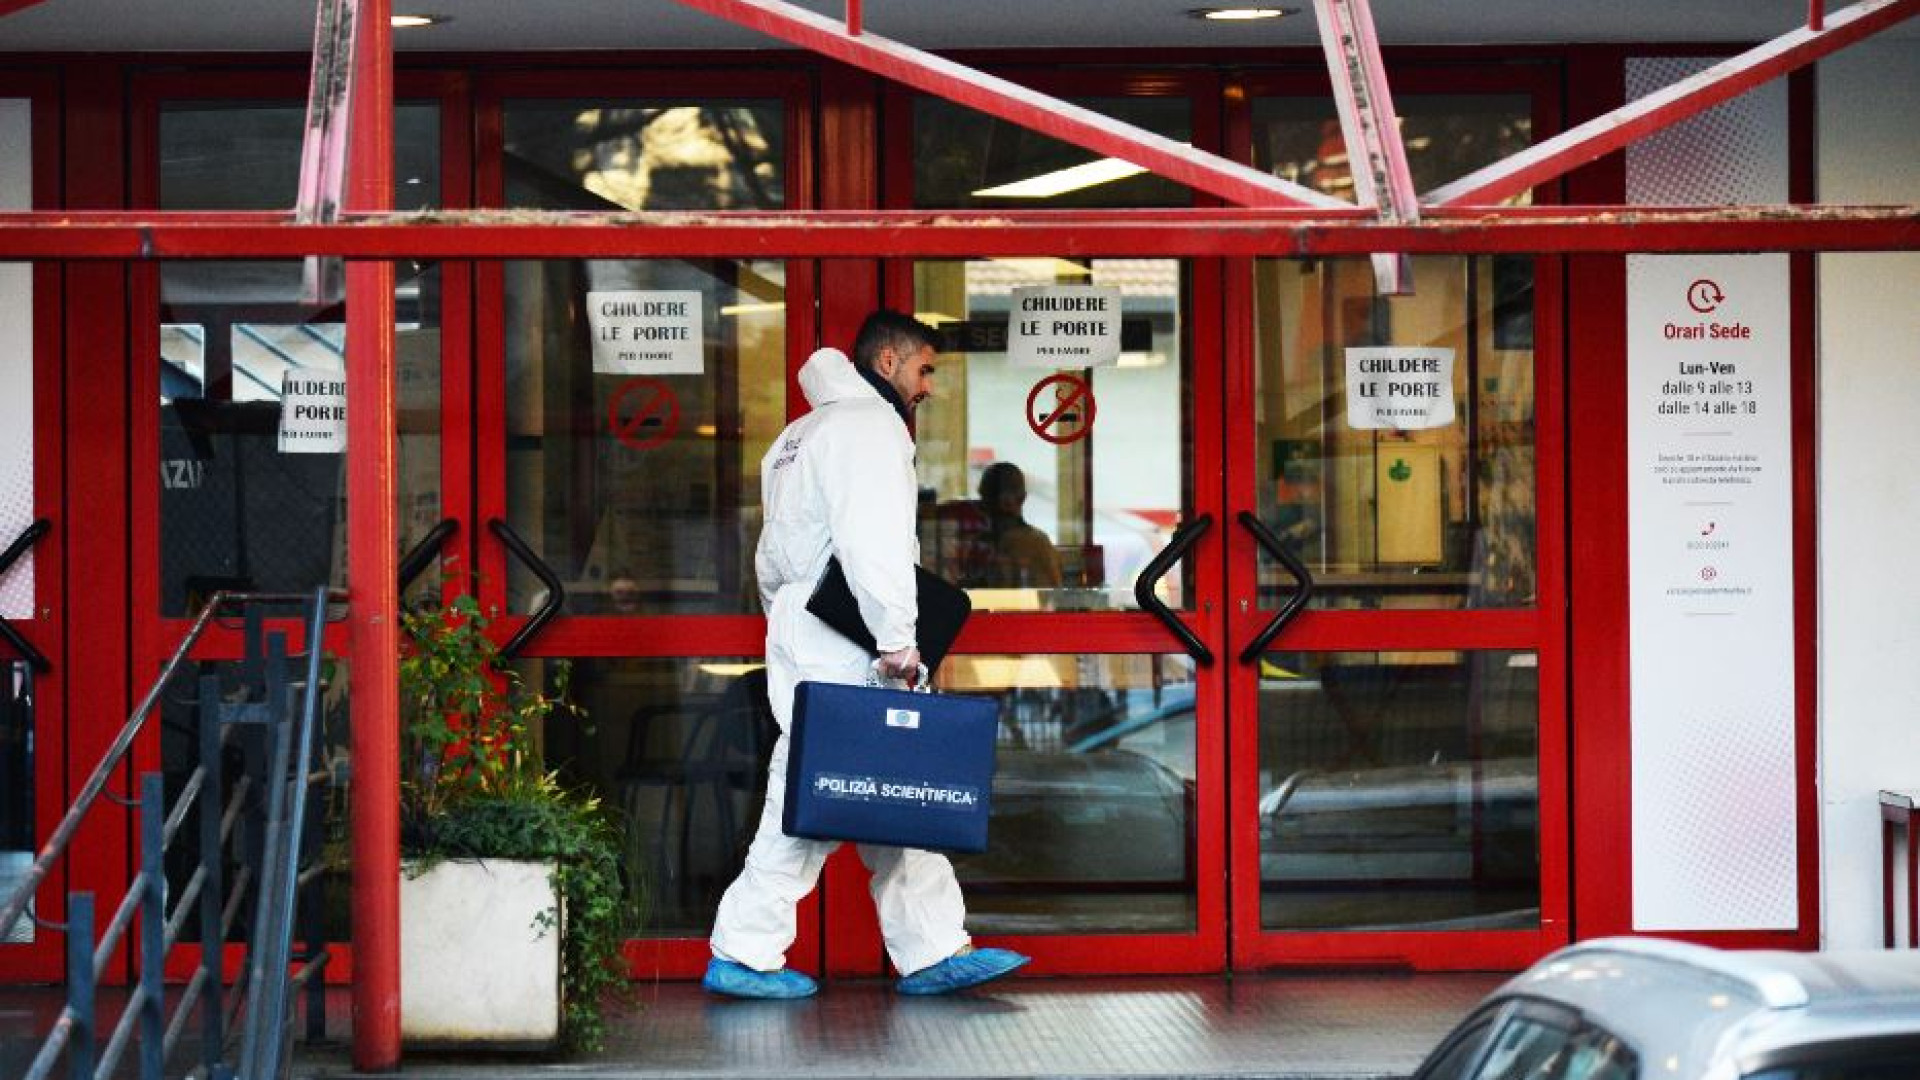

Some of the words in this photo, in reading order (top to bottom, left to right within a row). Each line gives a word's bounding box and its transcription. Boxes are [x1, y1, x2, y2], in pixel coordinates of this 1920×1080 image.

[602, 301, 689, 317] CHIUDERE
[1022, 296, 1108, 311] CHIUDERE
[602, 326, 622, 341] LE
[633, 326, 690, 341] PORTE
[1021, 320, 1041, 336] LE
[1053, 320, 1108, 336] PORTE
[1664, 322, 1705, 339] Orari
[1709, 322, 1750, 339] Sede
[1360, 358, 1441, 373] CHIUDERE
[1679, 361, 1736, 374] Lun-Ven
[1360, 382, 1379, 397] LE
[1388, 382, 1441, 397] PORTE
[1662, 380, 1694, 394] dalle
[1697, 380, 1705, 394] 9
[1709, 380, 1734, 394] alle
[1737, 380, 1752, 394] 13
[1658, 400, 1690, 414] dalle
[1693, 400, 1709, 414] 14
[1713, 400, 1738, 414] alle
[1742, 400, 1756, 414] 18
[817, 777, 878, 795] POLIZIA
[880, 783, 973, 805] SCIENTIFICA
